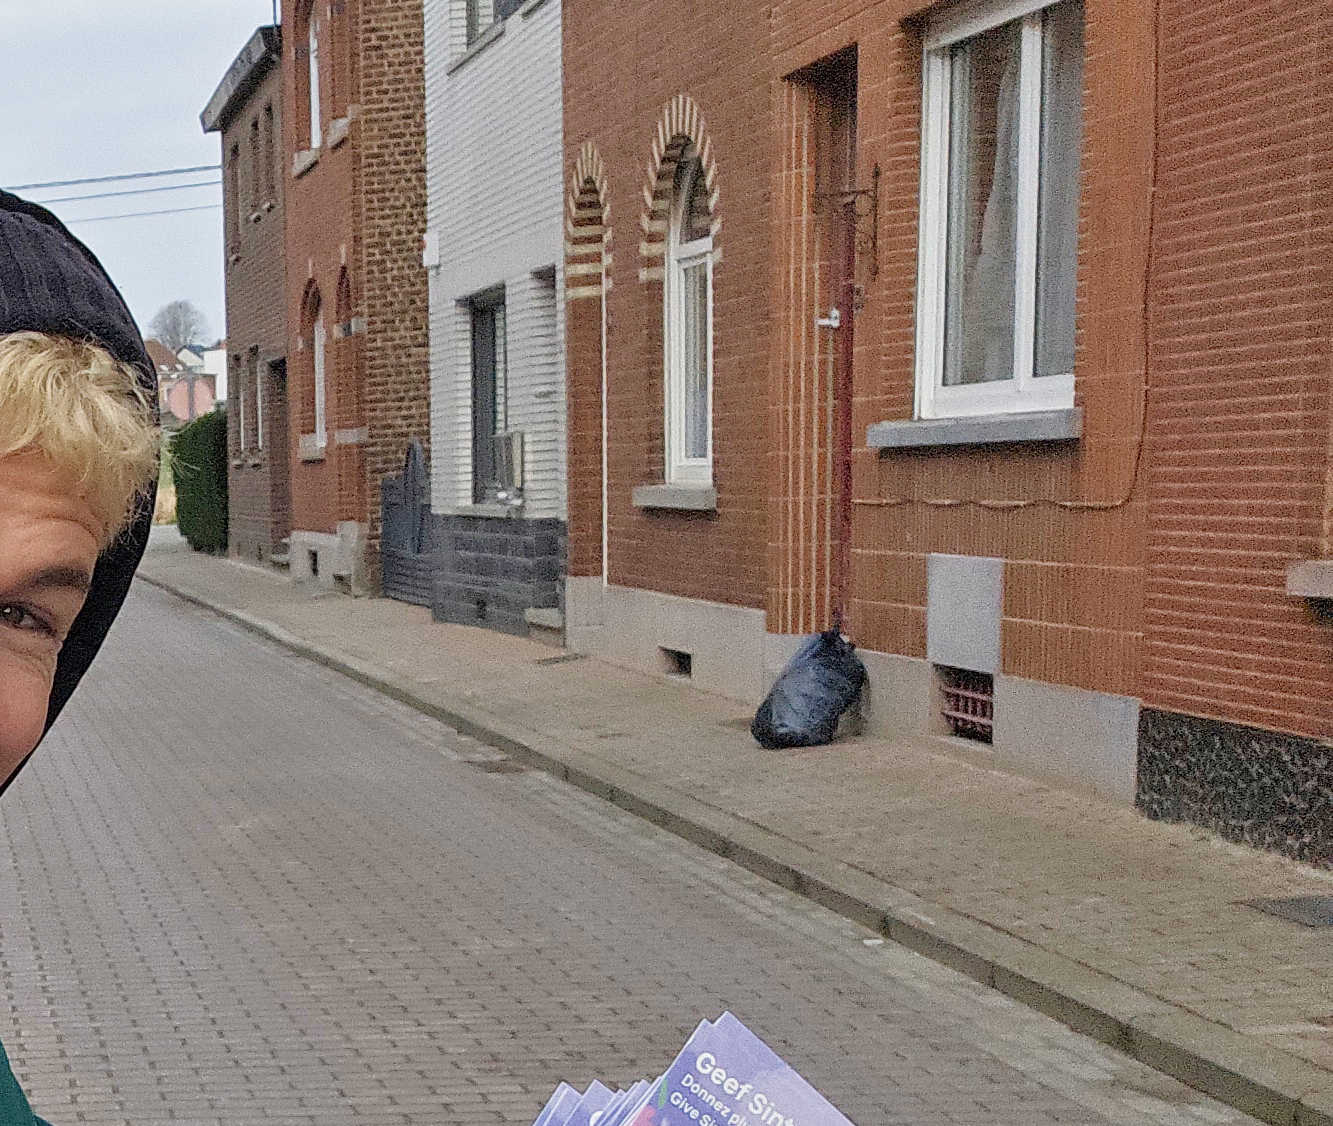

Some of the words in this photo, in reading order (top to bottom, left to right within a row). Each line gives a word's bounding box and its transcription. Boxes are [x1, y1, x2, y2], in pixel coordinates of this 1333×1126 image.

[680, 1073, 732, 1118] Donnez
[695, 1052, 753, 1101] Geef
[669, 1091, 699, 1120] Give
